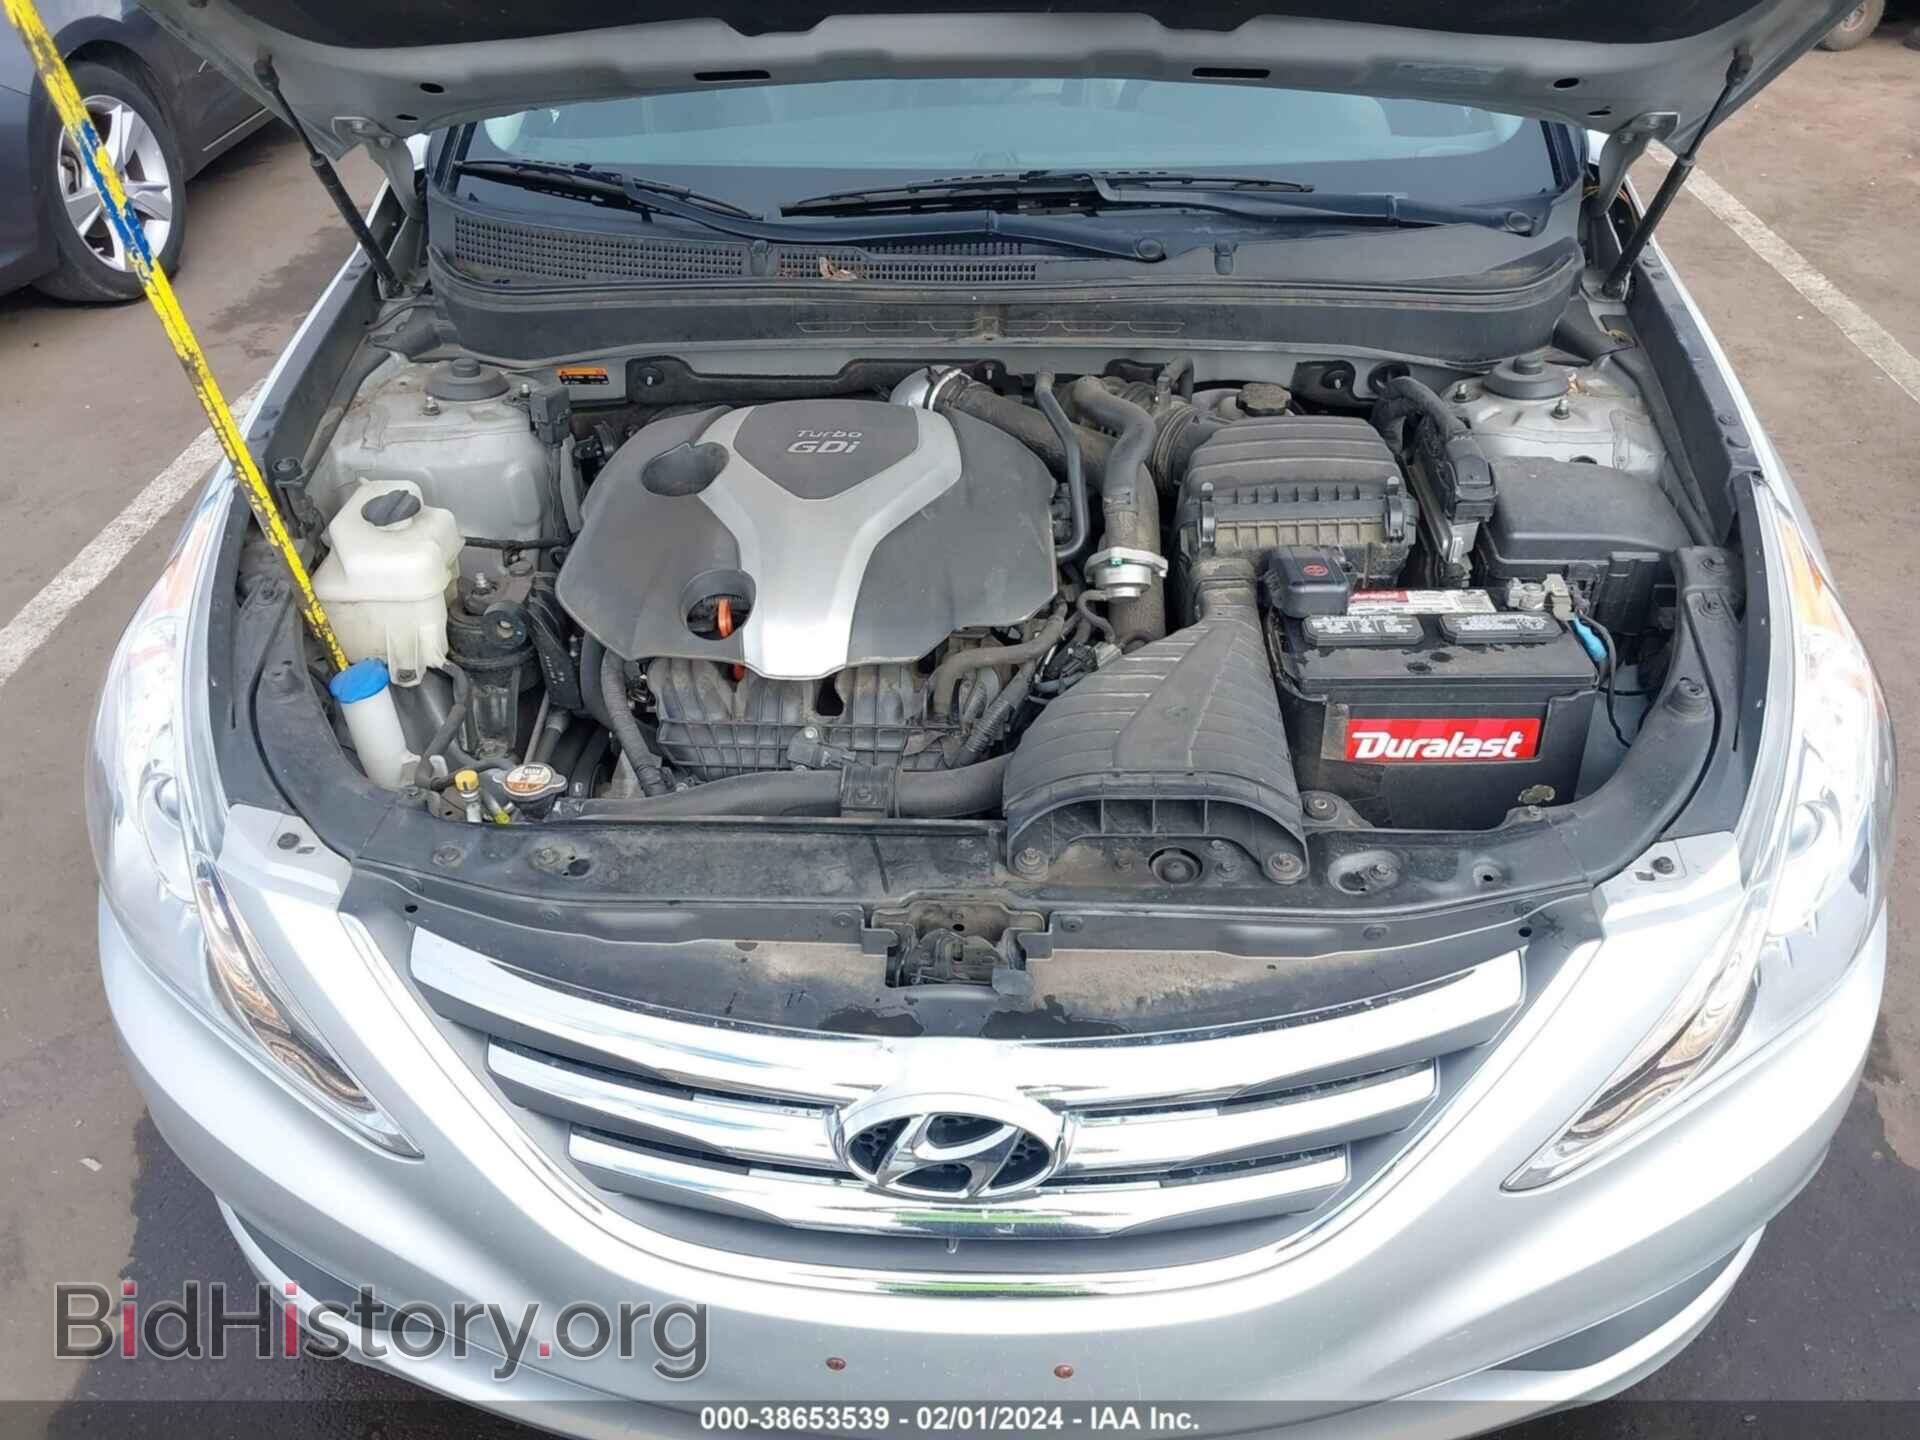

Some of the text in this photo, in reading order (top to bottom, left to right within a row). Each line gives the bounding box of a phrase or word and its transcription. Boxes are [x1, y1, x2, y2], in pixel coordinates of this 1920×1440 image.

[797, 429, 863, 438] Turbo
[787, 440, 861, 453] GDi
[1352, 731, 1524, 759] Duralast
